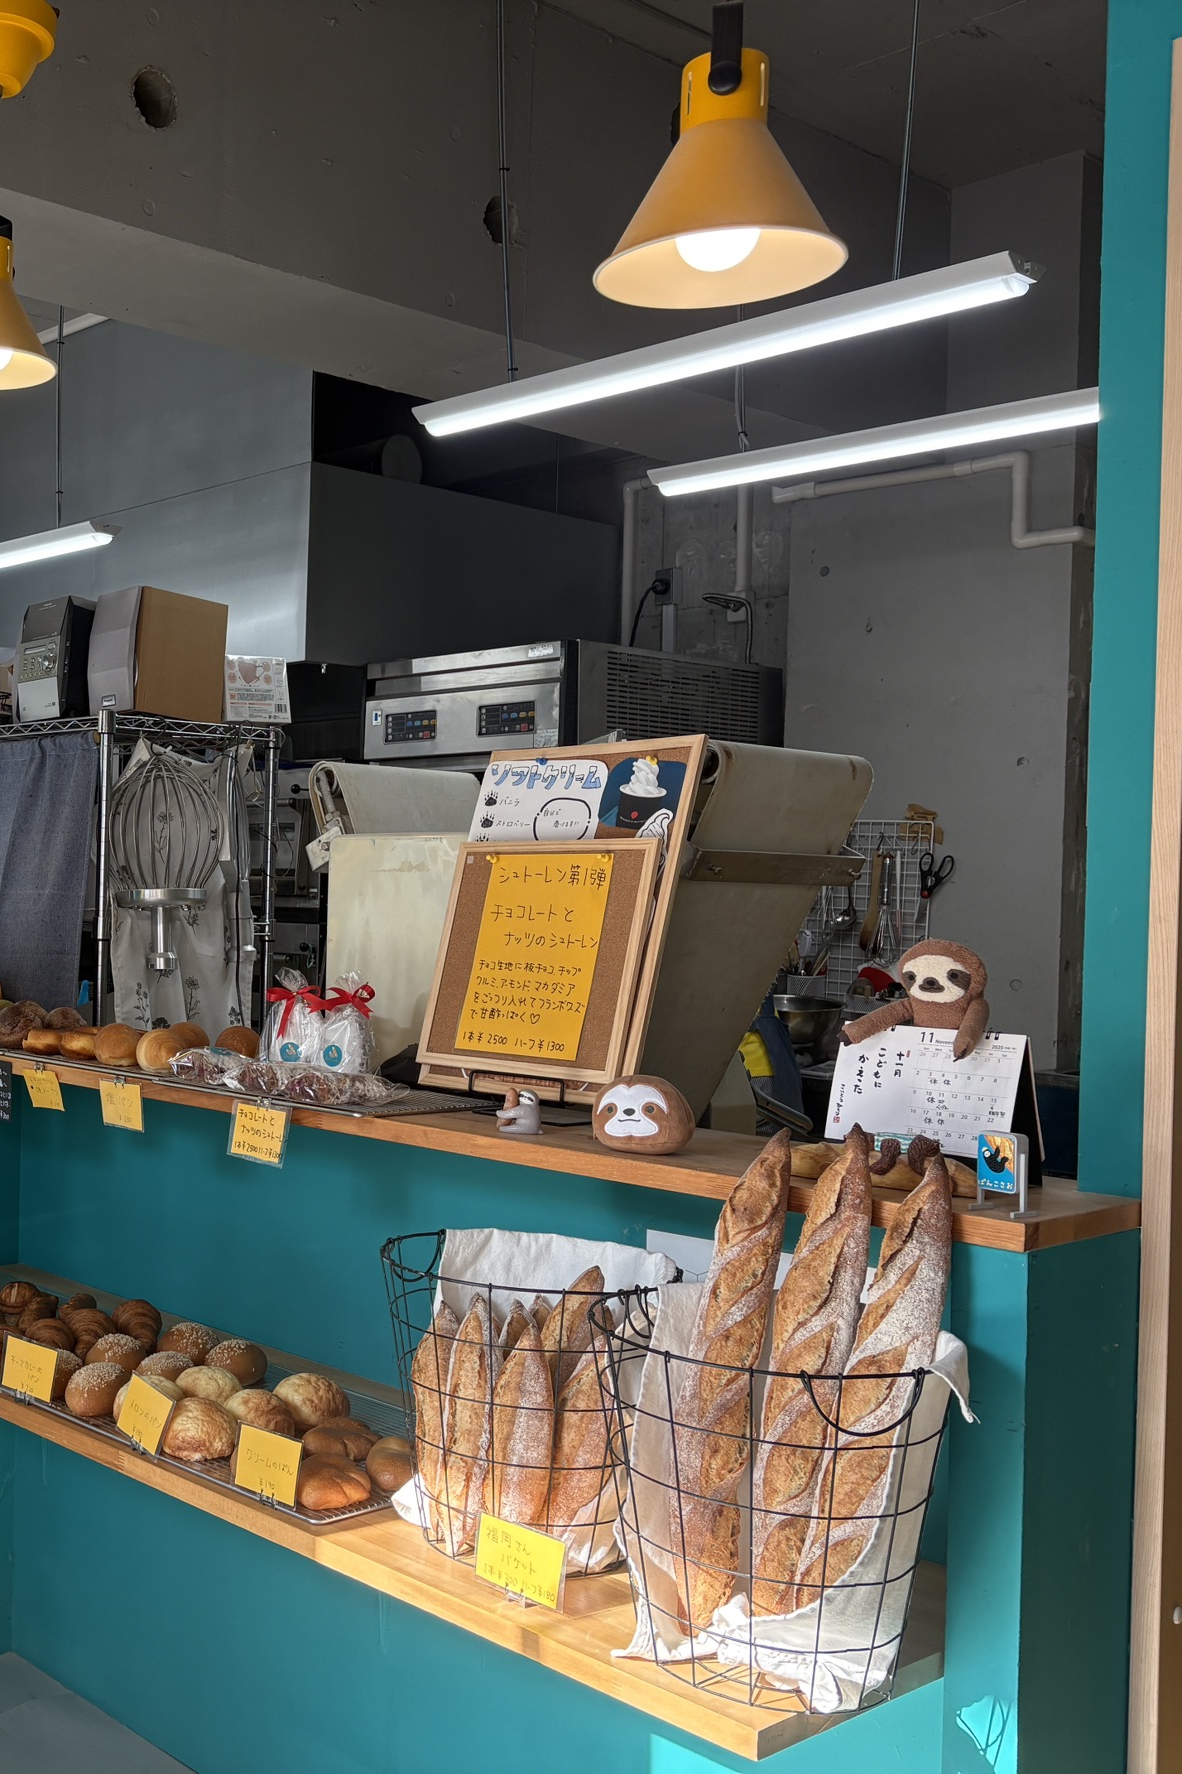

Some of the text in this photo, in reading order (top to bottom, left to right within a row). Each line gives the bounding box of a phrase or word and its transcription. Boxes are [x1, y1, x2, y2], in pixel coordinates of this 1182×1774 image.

[491, 764, 601, 790] ソフトクリーム
[499, 796, 520, 807] バニラ
[495, 820, 531, 828] ストロベリー
[499, 864, 607, 890] シュトーレン第1弾
[490, 904, 574, 923] チョコレートと
[504, 931, 598, 949] ナッツのシュトーレン
[920, 1031, 935, 1043] 11
[873, 1047, 888, 1088] こどもに
[894, 1051, 905, 1077] 十一月
[854, 1054, 869, 1094] かえった
[239, 1108, 275, 1126] チョコレートと
